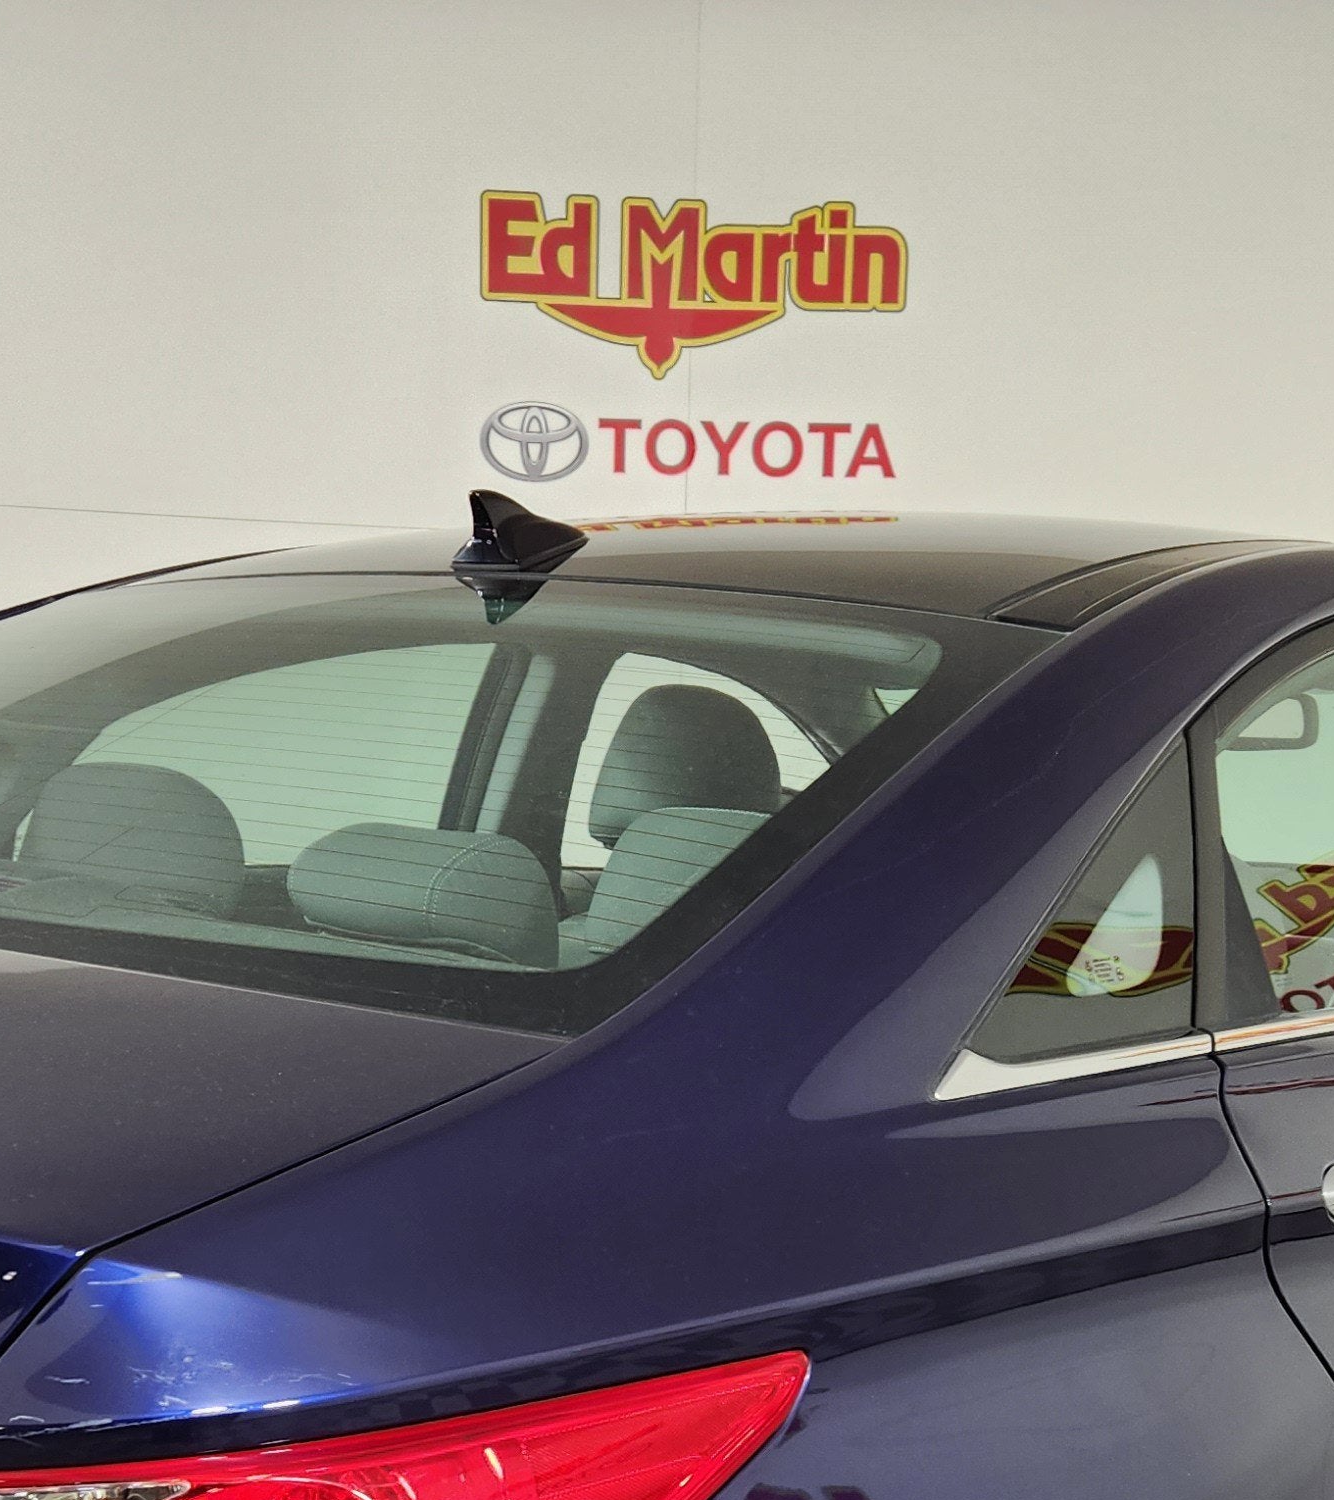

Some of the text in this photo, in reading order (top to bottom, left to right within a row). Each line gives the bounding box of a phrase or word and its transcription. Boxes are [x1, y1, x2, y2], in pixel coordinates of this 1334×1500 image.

[481, 190, 908, 311] Ed Martin
[598, 418, 896, 479] TOYOTA
